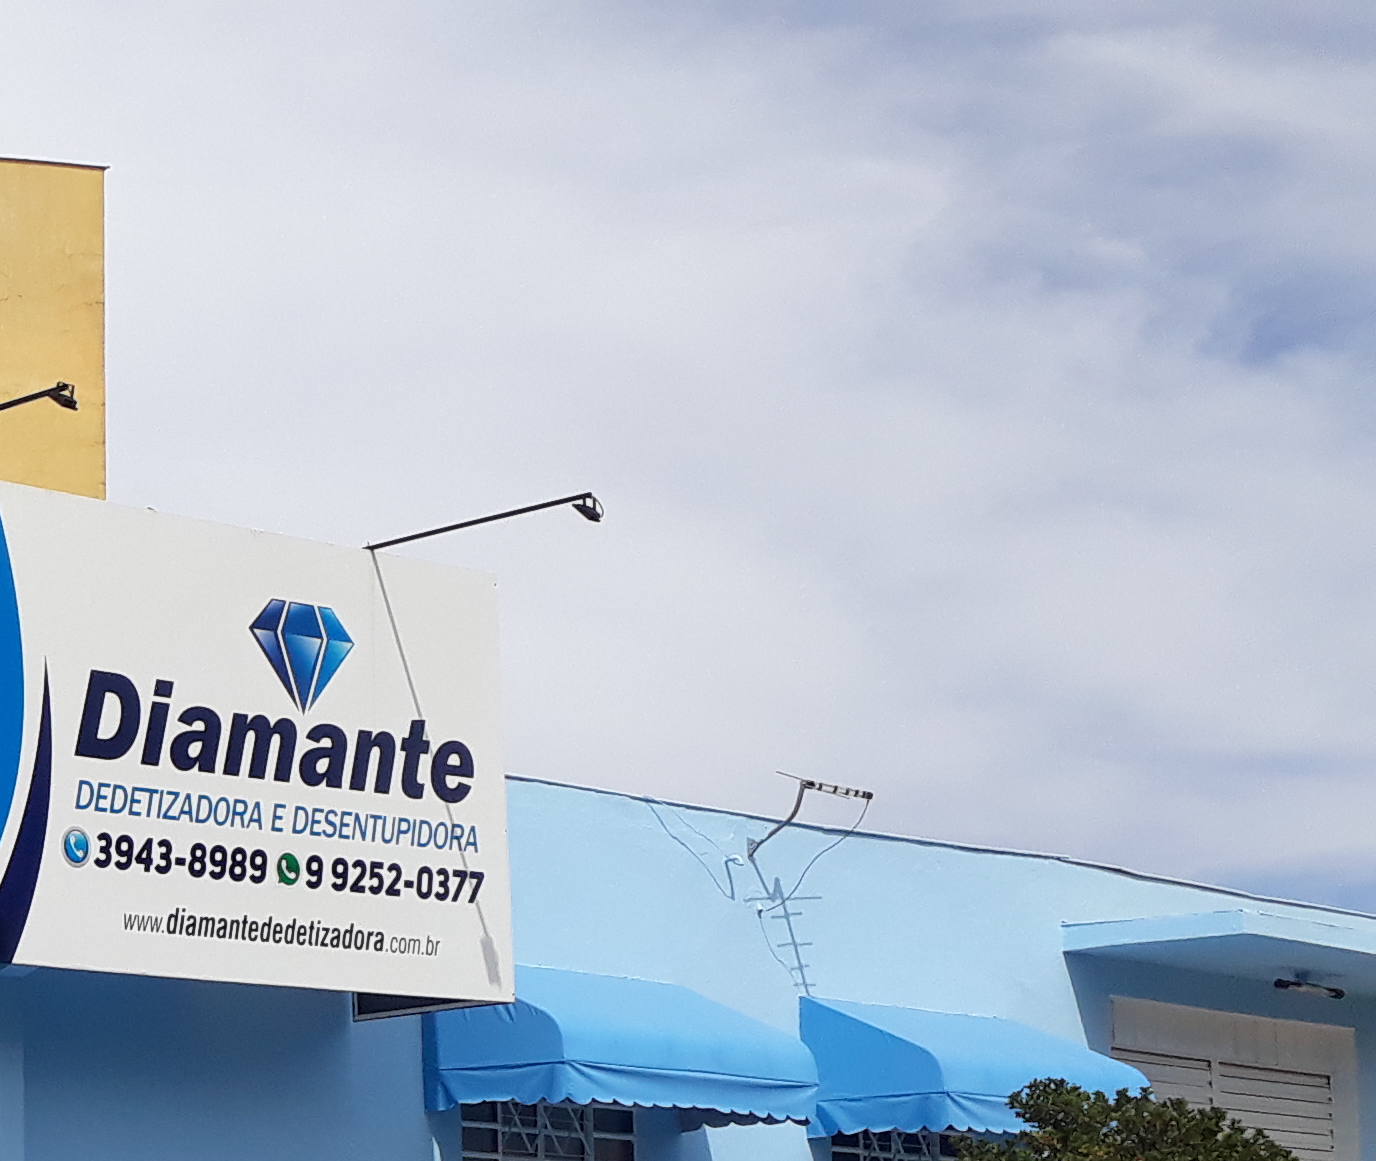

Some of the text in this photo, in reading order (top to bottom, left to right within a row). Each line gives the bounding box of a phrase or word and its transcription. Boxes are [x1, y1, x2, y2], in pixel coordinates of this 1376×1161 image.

[74, 669, 475, 804] Diamante
[75, 779, 479, 853] DEDETIZADORA E DESENTUPIDORA
[93, 832, 485, 903] 3943-8989 9 9252-0377
[123, 906, 440, 957] www.diamantededetizadora.com.br
